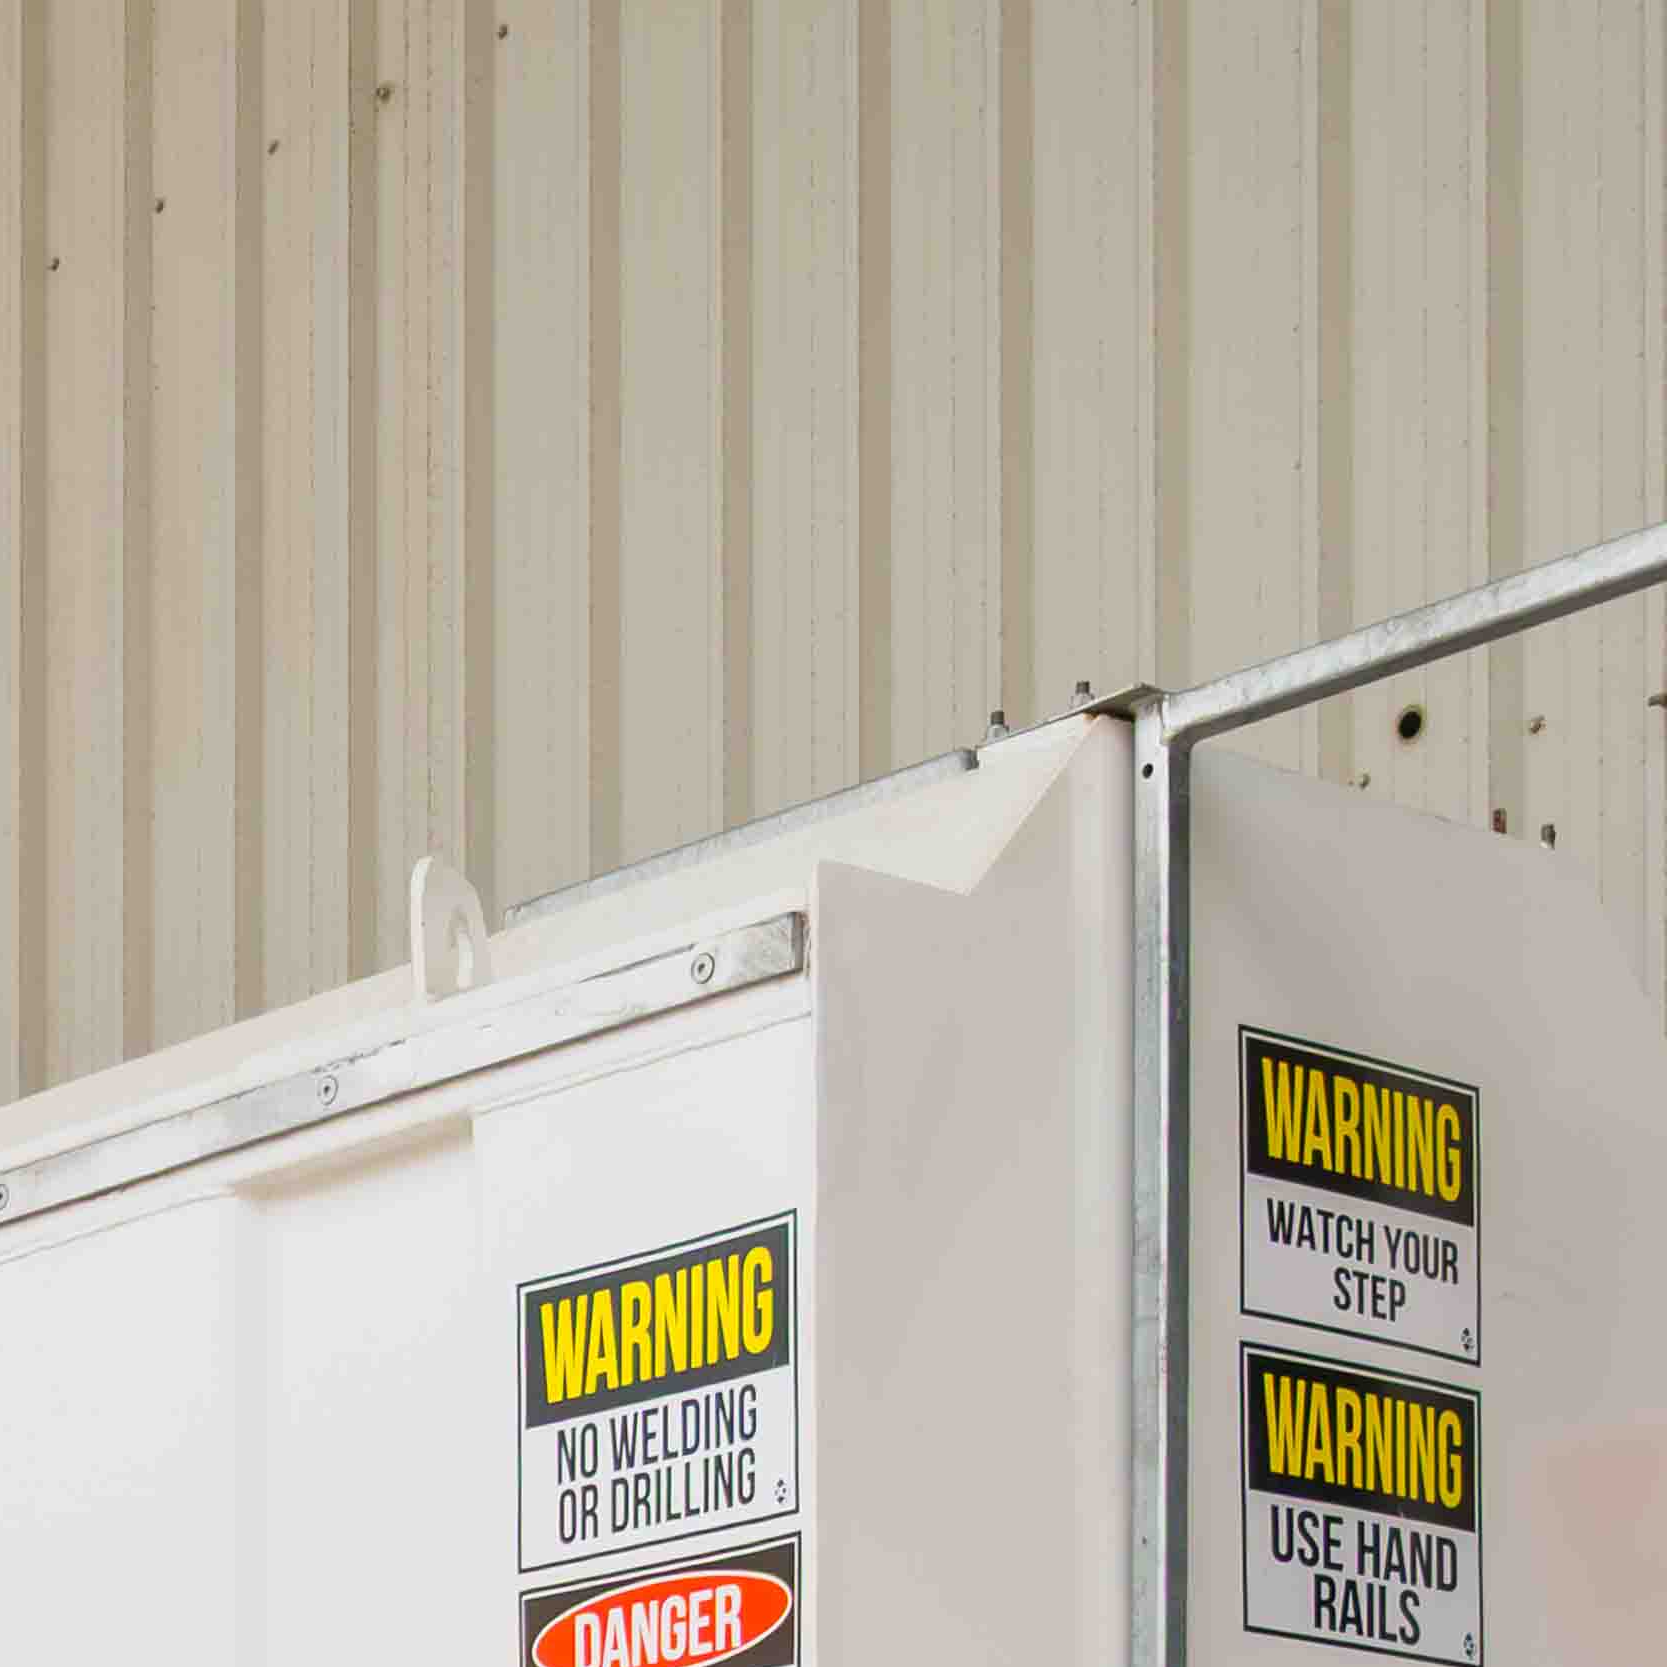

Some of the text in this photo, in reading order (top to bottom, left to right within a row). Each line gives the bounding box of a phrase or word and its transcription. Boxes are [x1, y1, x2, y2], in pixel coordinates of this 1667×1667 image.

[1262, 1056, 1461, 1201] WARNING
[1267, 1197, 1458, 1285] WATCH YOUR
[540, 1246, 773, 1404] WARNING
[1333, 1267, 1406, 1322] STEP
[557, 1384, 757, 1485] NO WELDING
[1263, 1372, 1462, 1509] WARNING
[559, 1447, 755, 1545] OR DRILLING
[1271, 1504, 1457, 1592] USE HAND
[1314, 1574, 1420, 1646] RAILS
